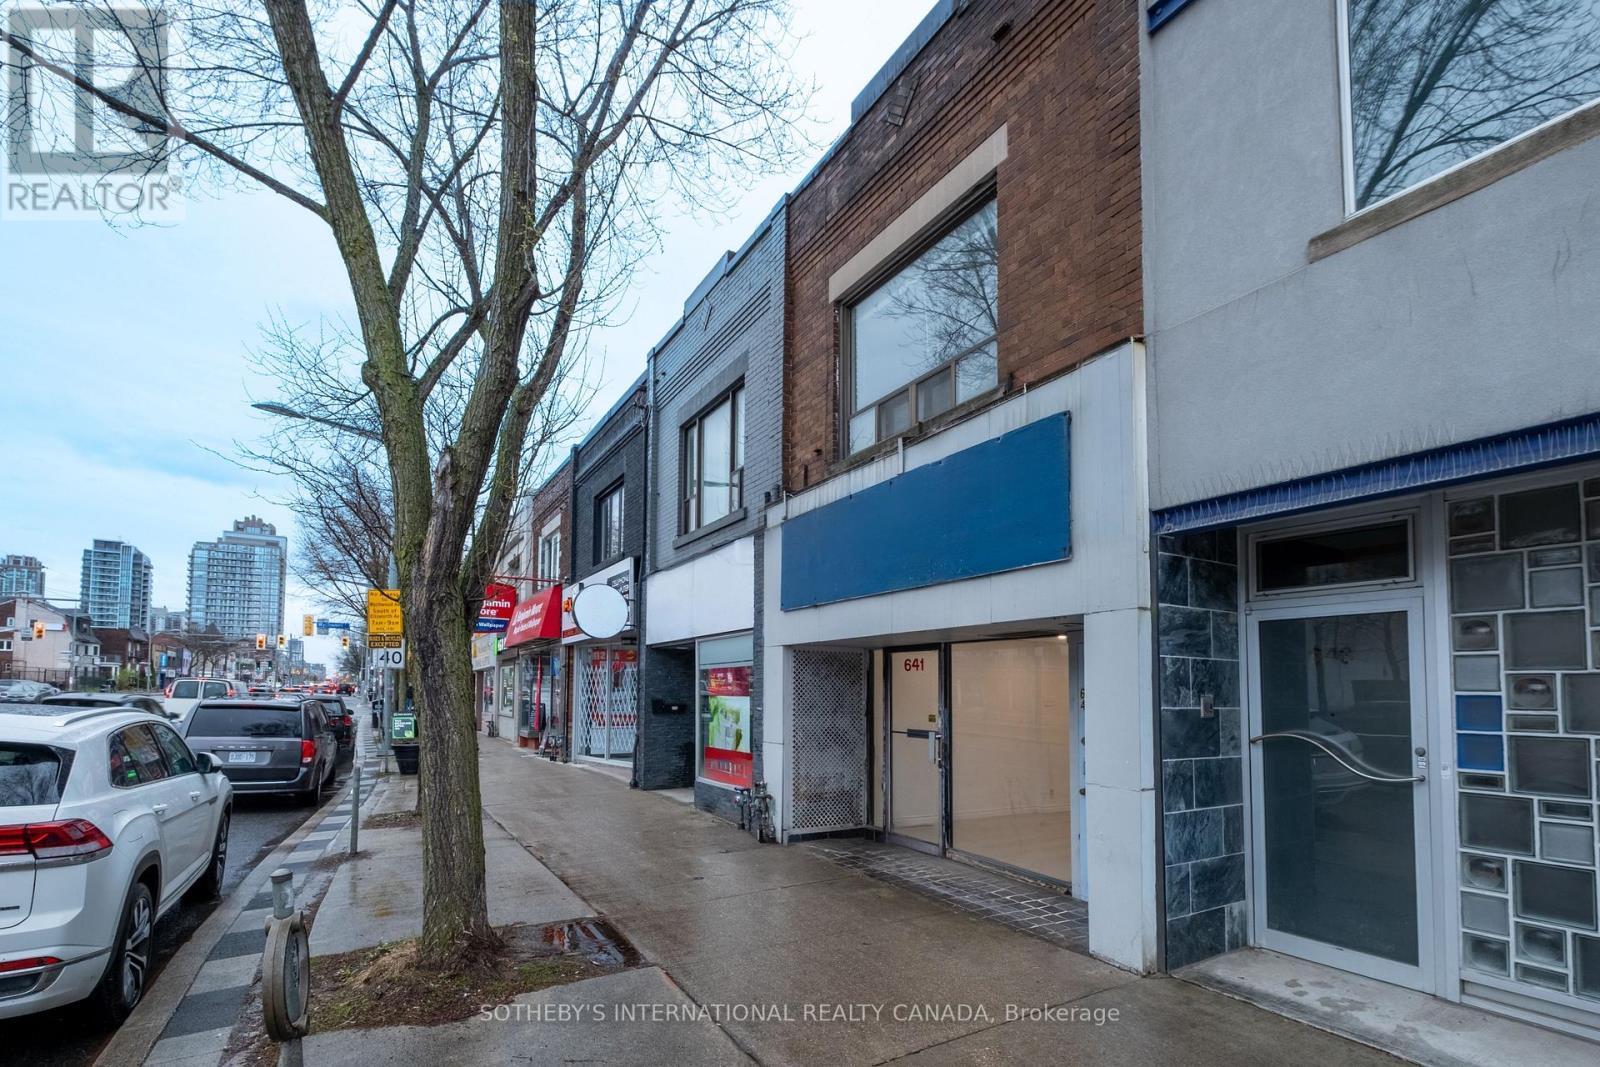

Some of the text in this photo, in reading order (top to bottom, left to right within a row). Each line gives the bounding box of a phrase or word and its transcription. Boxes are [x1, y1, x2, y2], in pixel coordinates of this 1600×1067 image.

[482, 599, 510, 608] jamin
[379, 651, 402, 664] 40
[904, 658, 924, 672] 641
